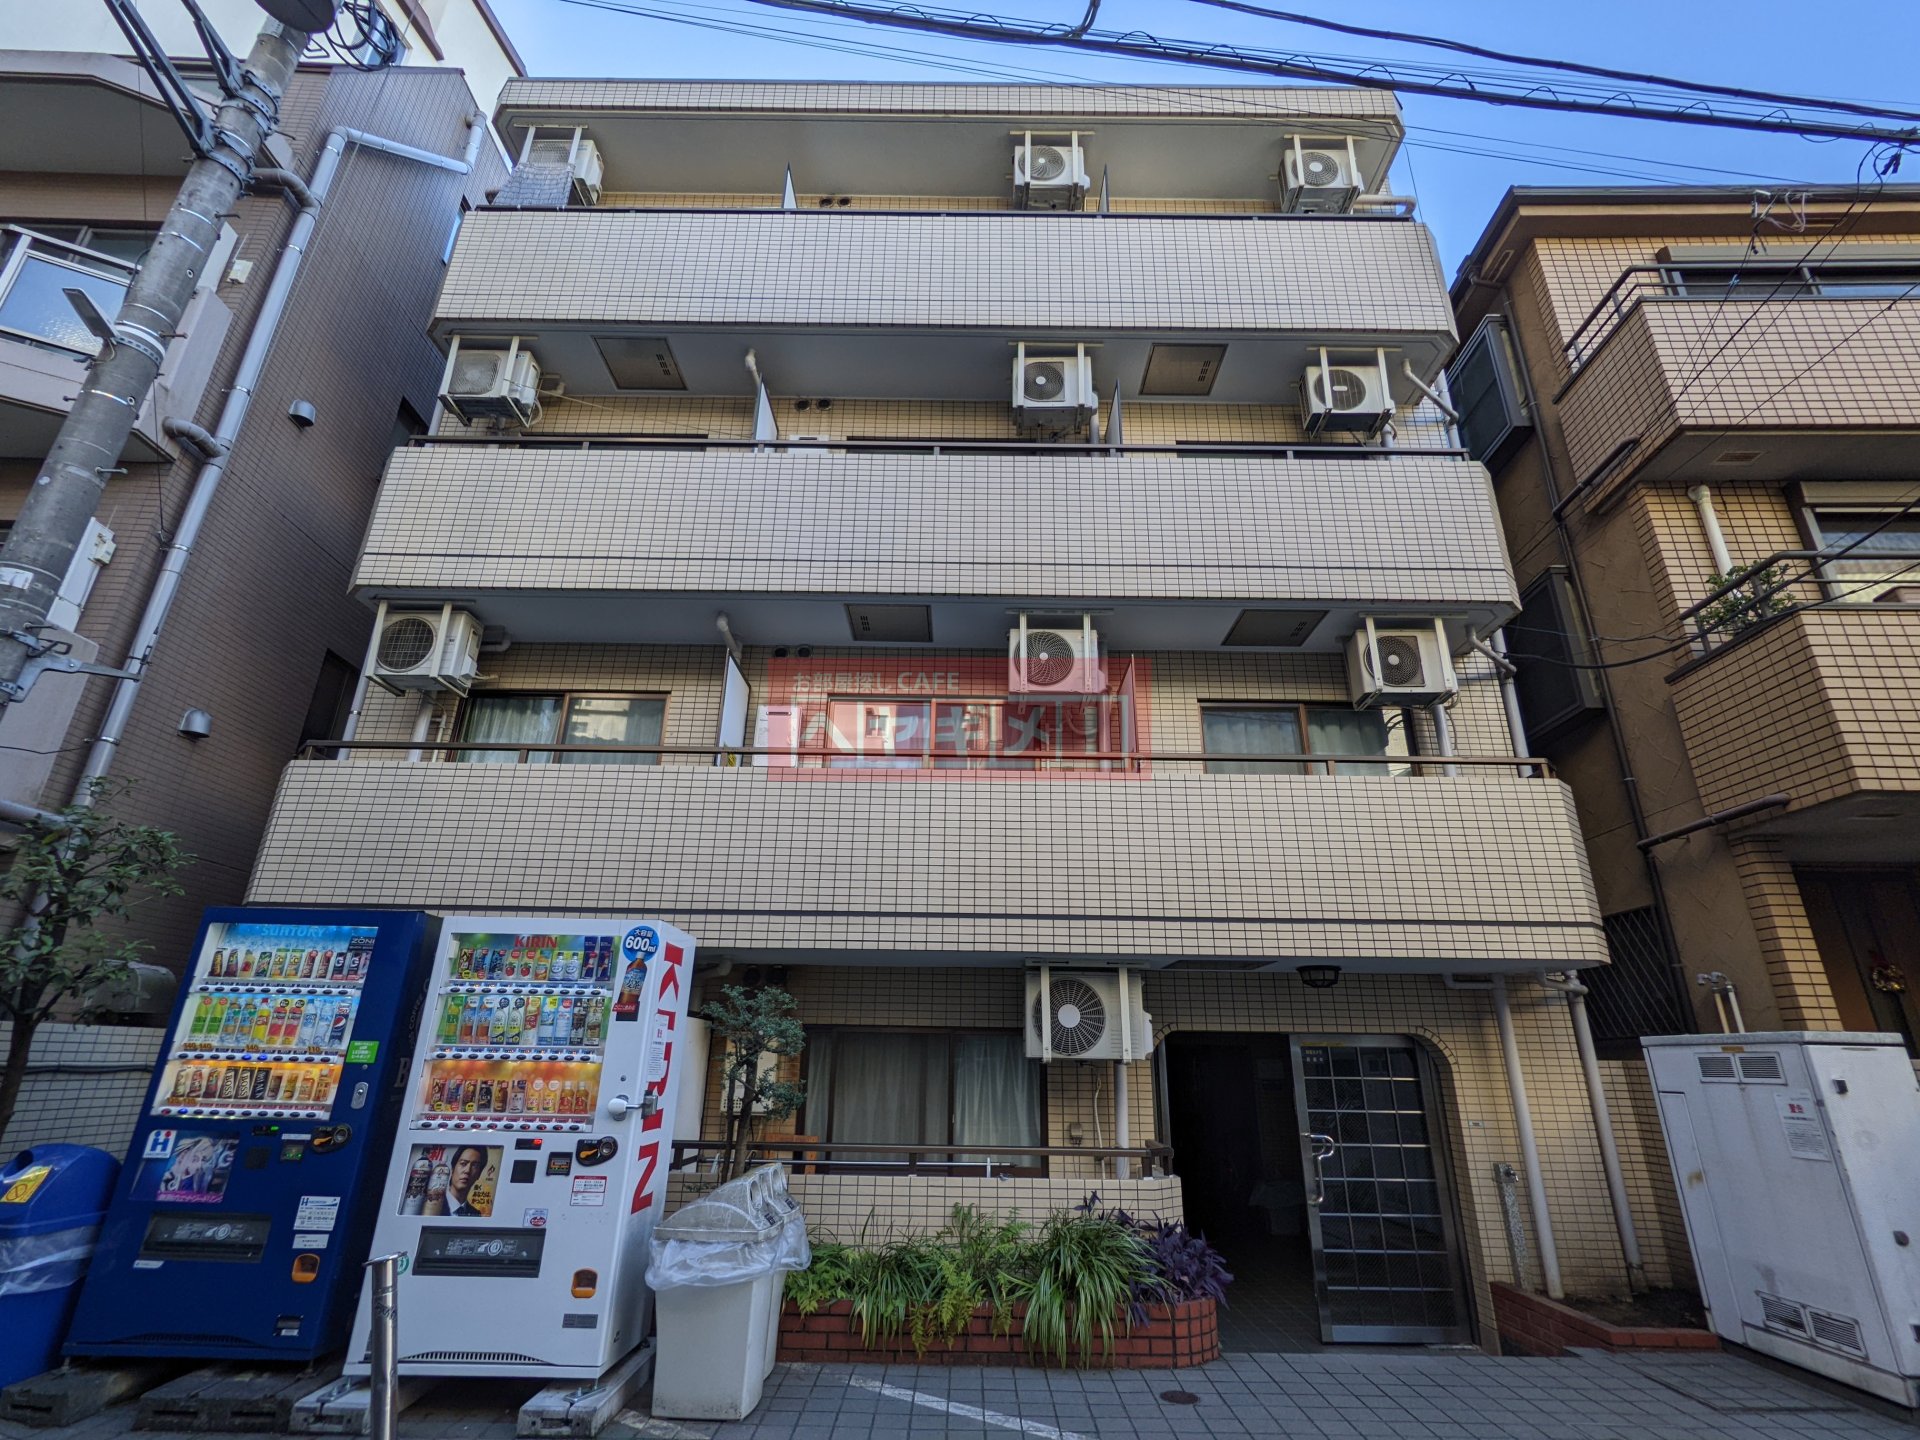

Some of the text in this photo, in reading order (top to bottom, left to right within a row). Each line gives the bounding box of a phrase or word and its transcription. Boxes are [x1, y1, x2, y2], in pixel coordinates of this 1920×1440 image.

[514, 935, 559, 949] KIRIN
[634, 929, 654, 938] 大容量
[625, 936, 657, 953] 600ml
[223, 1073, 233, 1097] BOSS
[240, 1074, 249, 1098] BOSS
